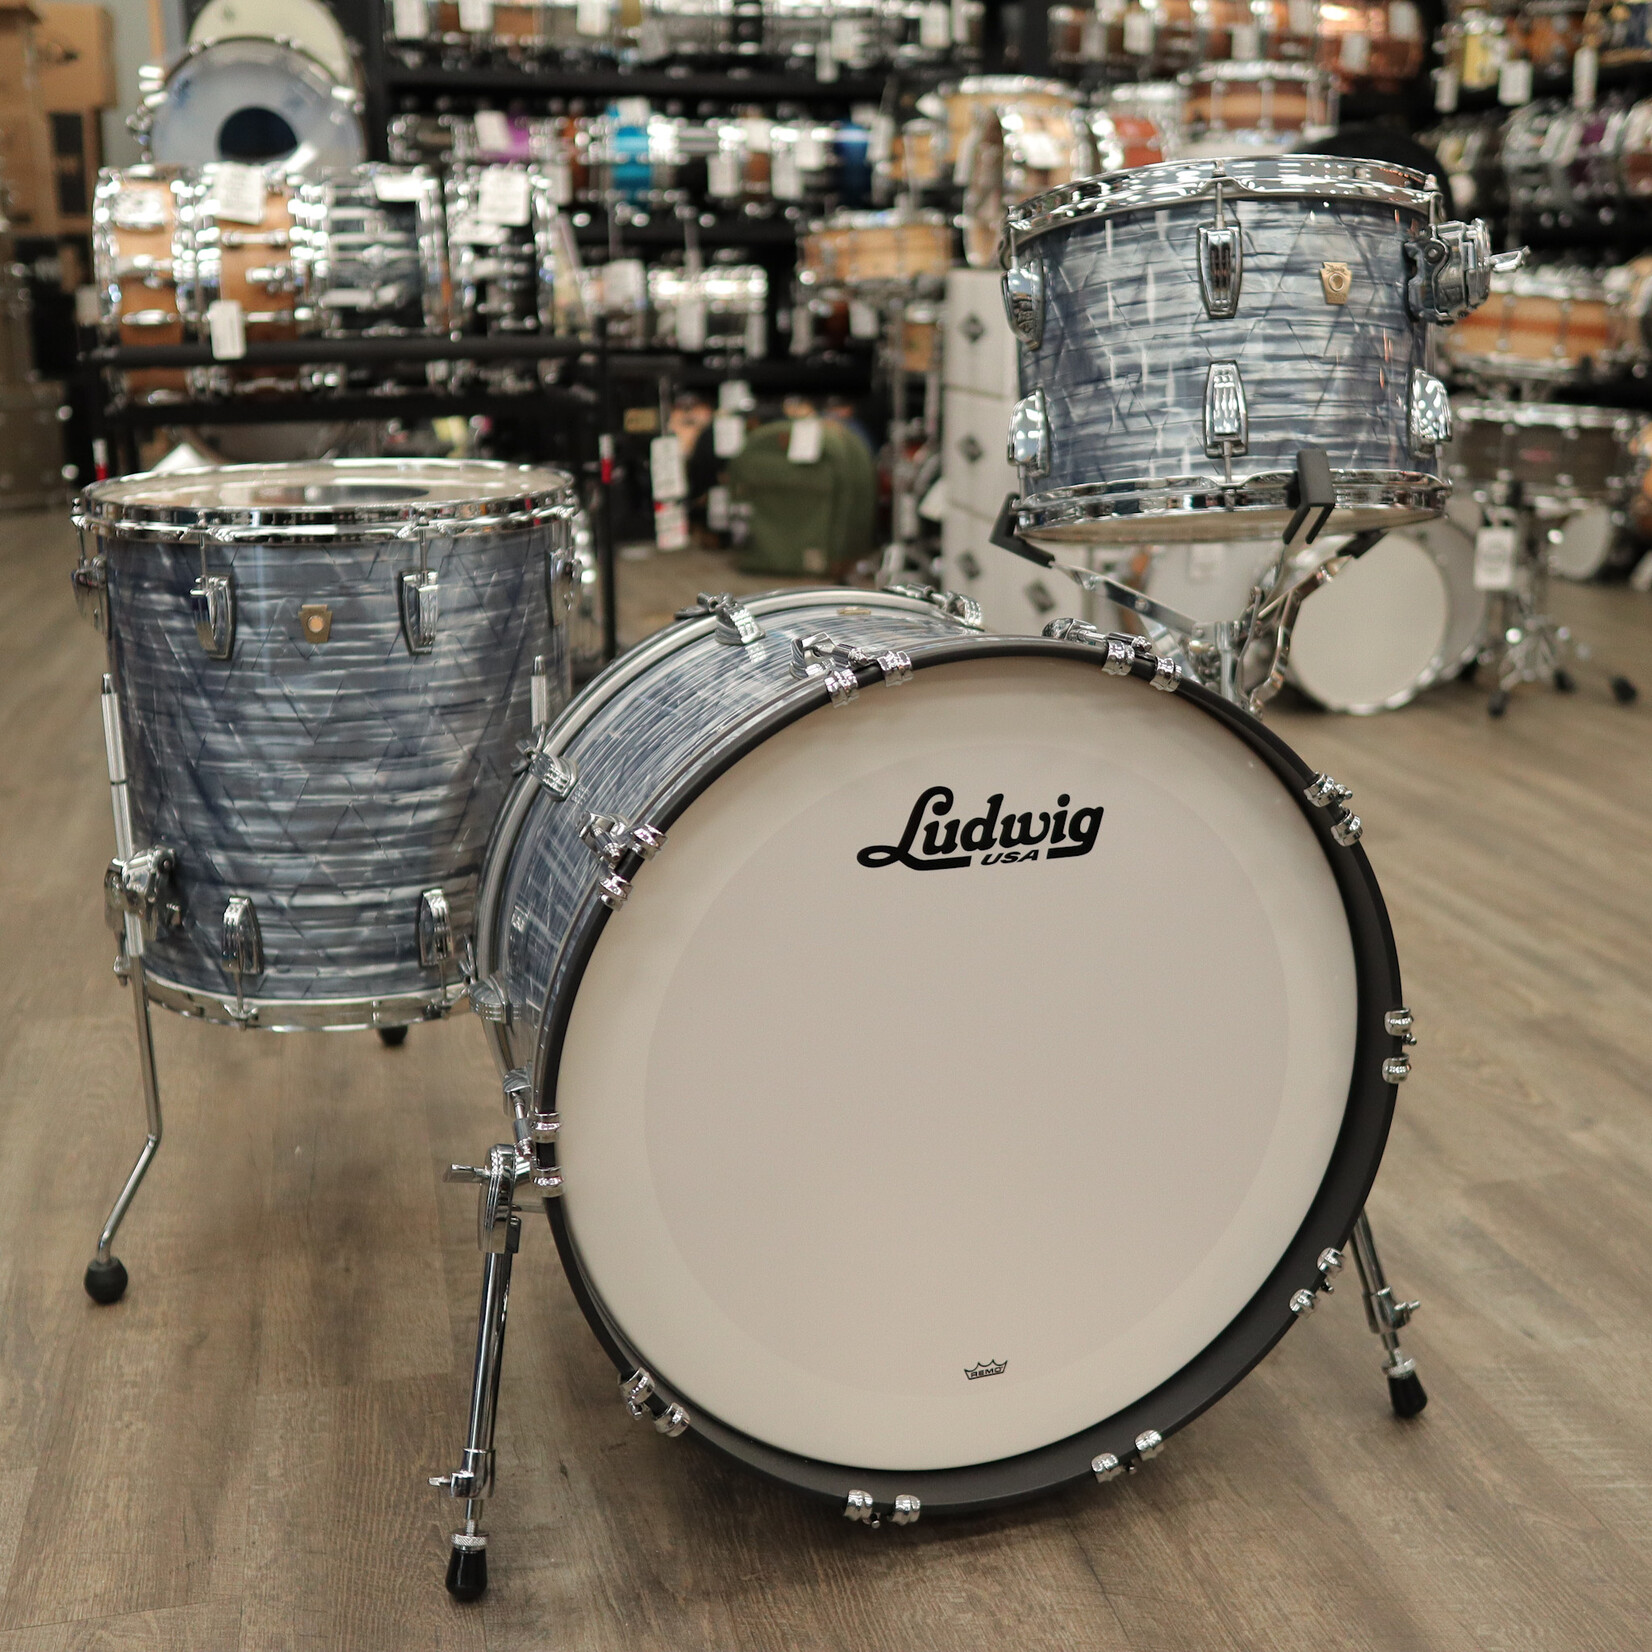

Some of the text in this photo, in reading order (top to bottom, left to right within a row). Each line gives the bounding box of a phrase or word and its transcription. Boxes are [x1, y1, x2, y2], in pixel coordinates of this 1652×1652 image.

[856, 785, 1105, 871] Ludwig
[980, 849, 1040, 866] USA
[970, 1366, 1003, 1378] REMO
